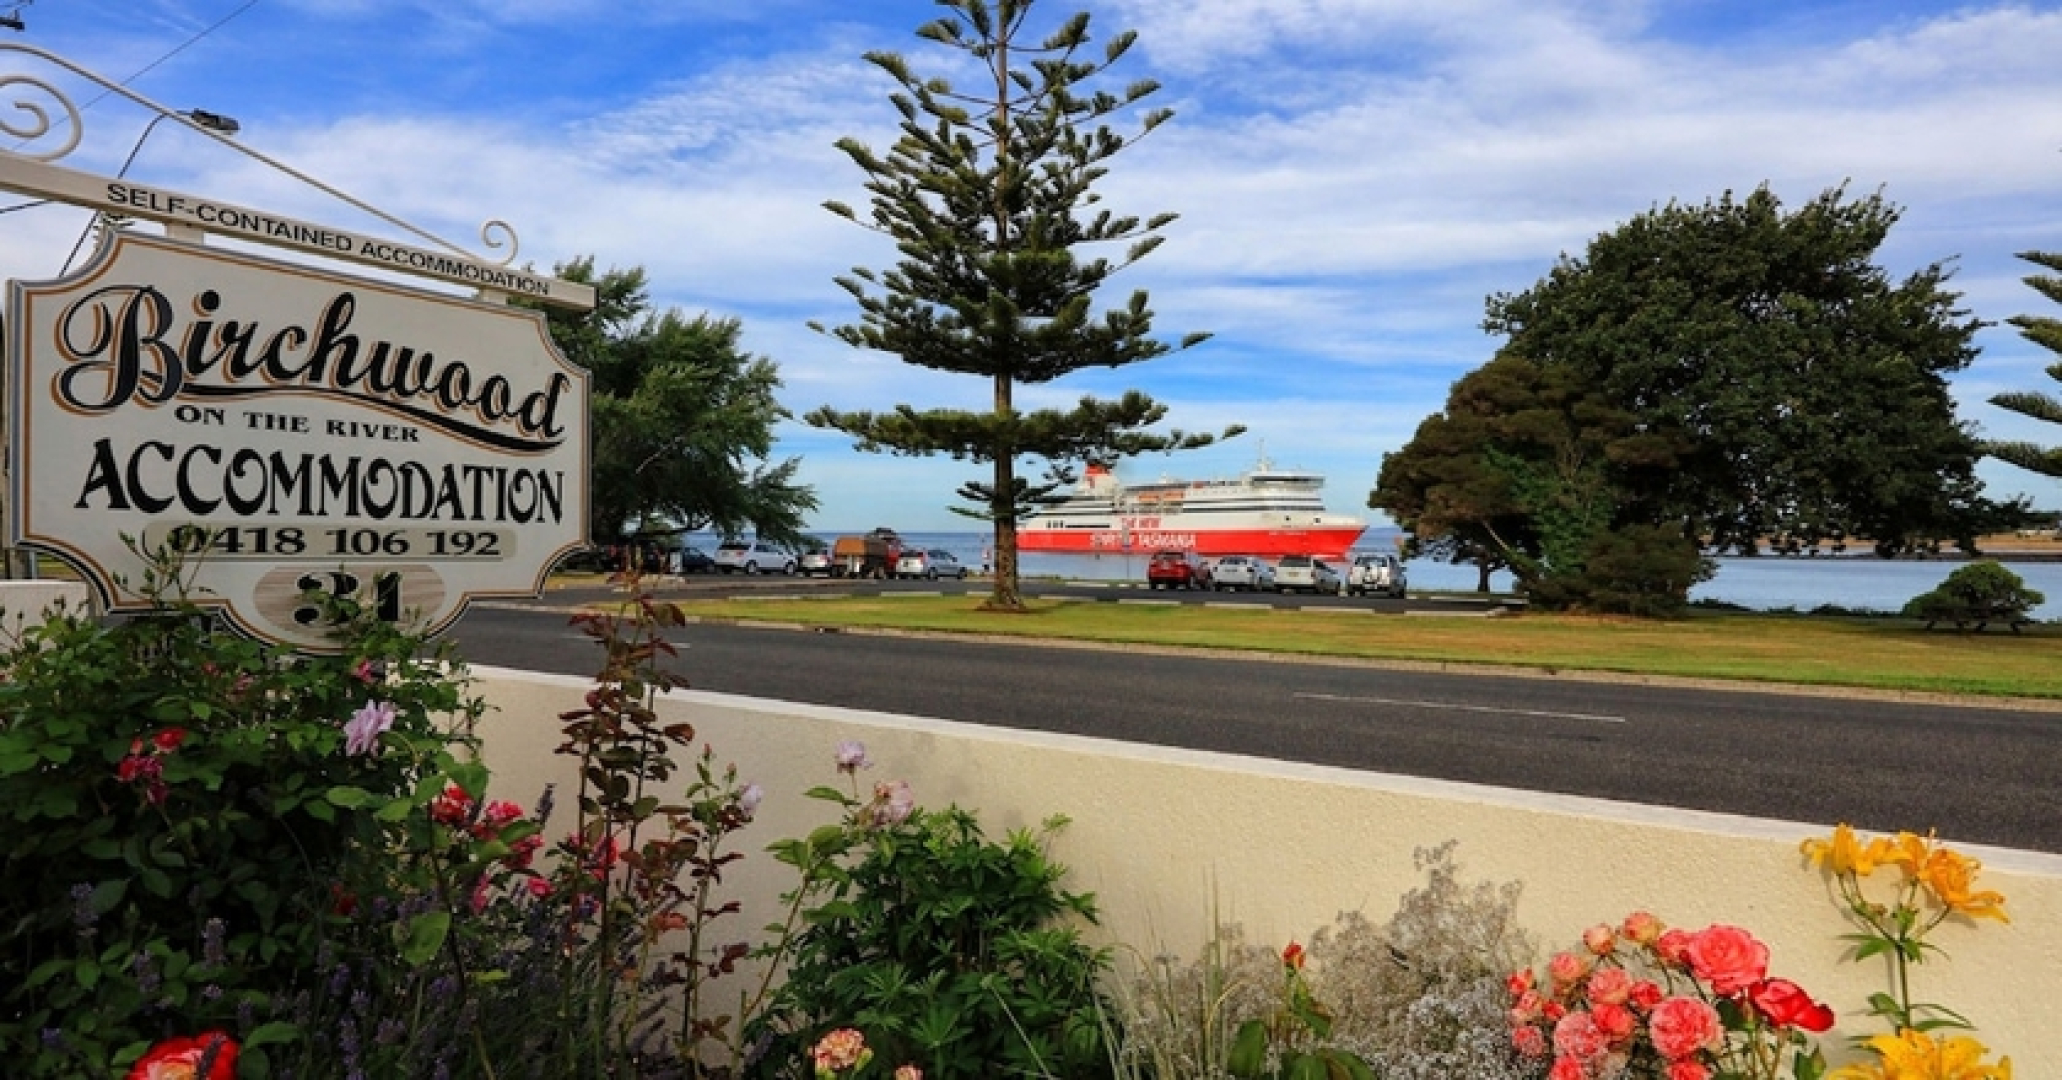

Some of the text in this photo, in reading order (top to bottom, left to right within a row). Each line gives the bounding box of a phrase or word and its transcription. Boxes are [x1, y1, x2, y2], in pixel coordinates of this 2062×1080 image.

[107, 183, 549, 295] SELF-CONTAINED ACCOMMODATION
[53, 284, 570, 439] Birchwood
[174, 405, 419, 443] ON THE RIVER
[74, 437, 565, 524] ACCOMMODATION
[325, 528, 410, 556] 106
[426, 531, 501, 556] 192
